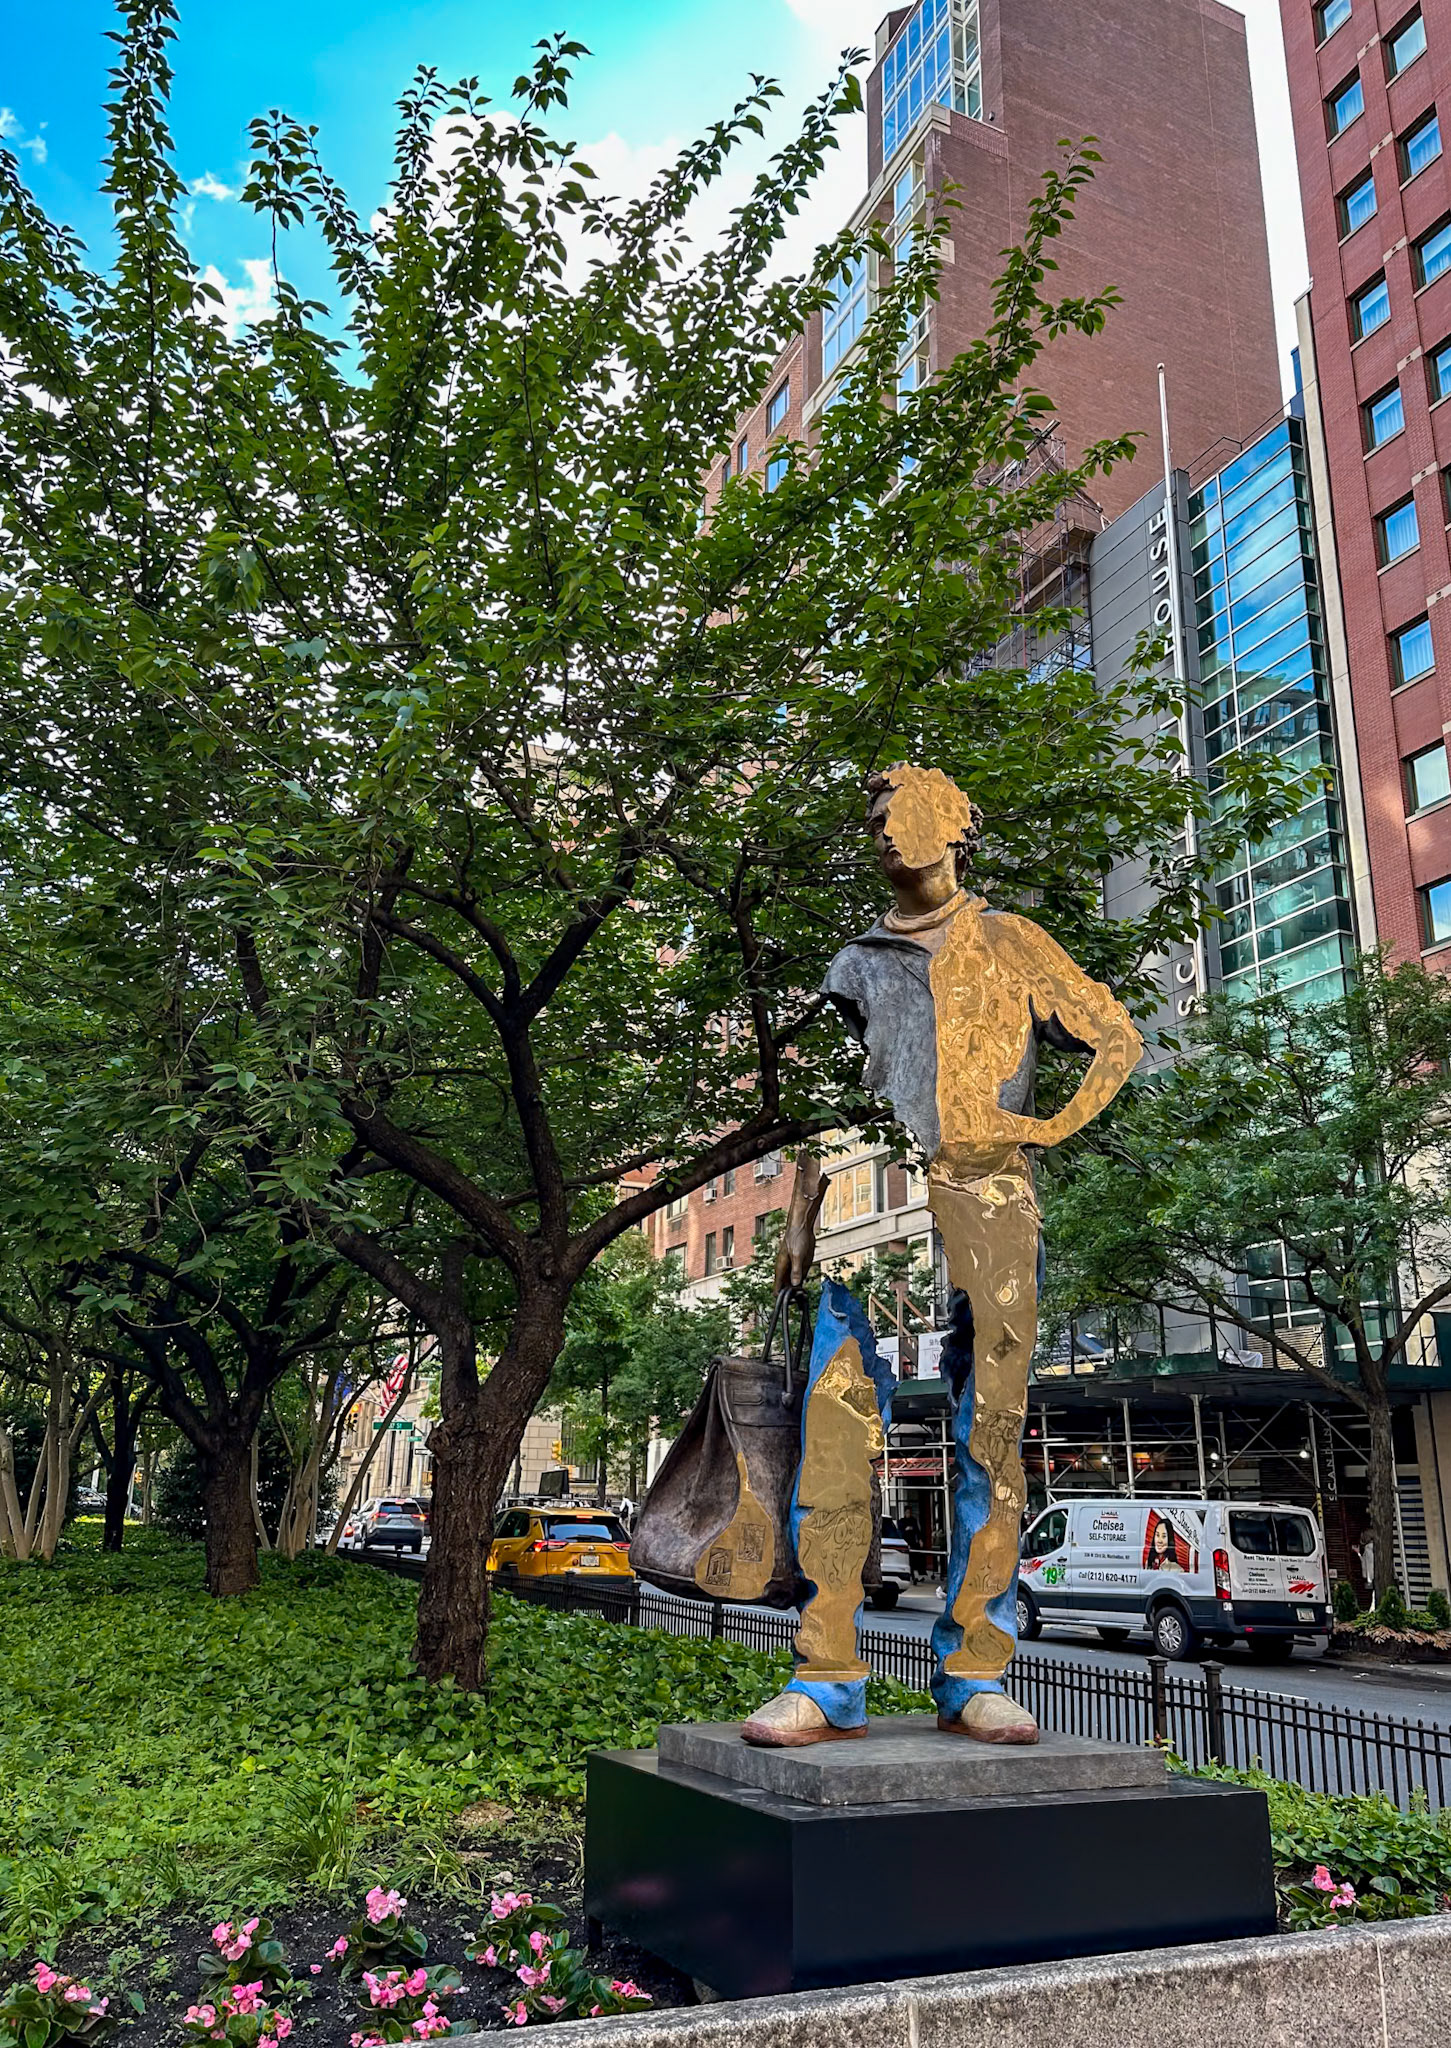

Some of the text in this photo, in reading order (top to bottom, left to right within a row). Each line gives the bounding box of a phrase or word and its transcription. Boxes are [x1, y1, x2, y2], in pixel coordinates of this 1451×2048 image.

[1092, 1519, 1124, 1531] Chelsea
[1089, 1533, 1126, 1542] SELF-STORAGE
[1087, 1571, 1105, 1581] (212)
[1105, 1573, 1137, 1584] 620-4177
